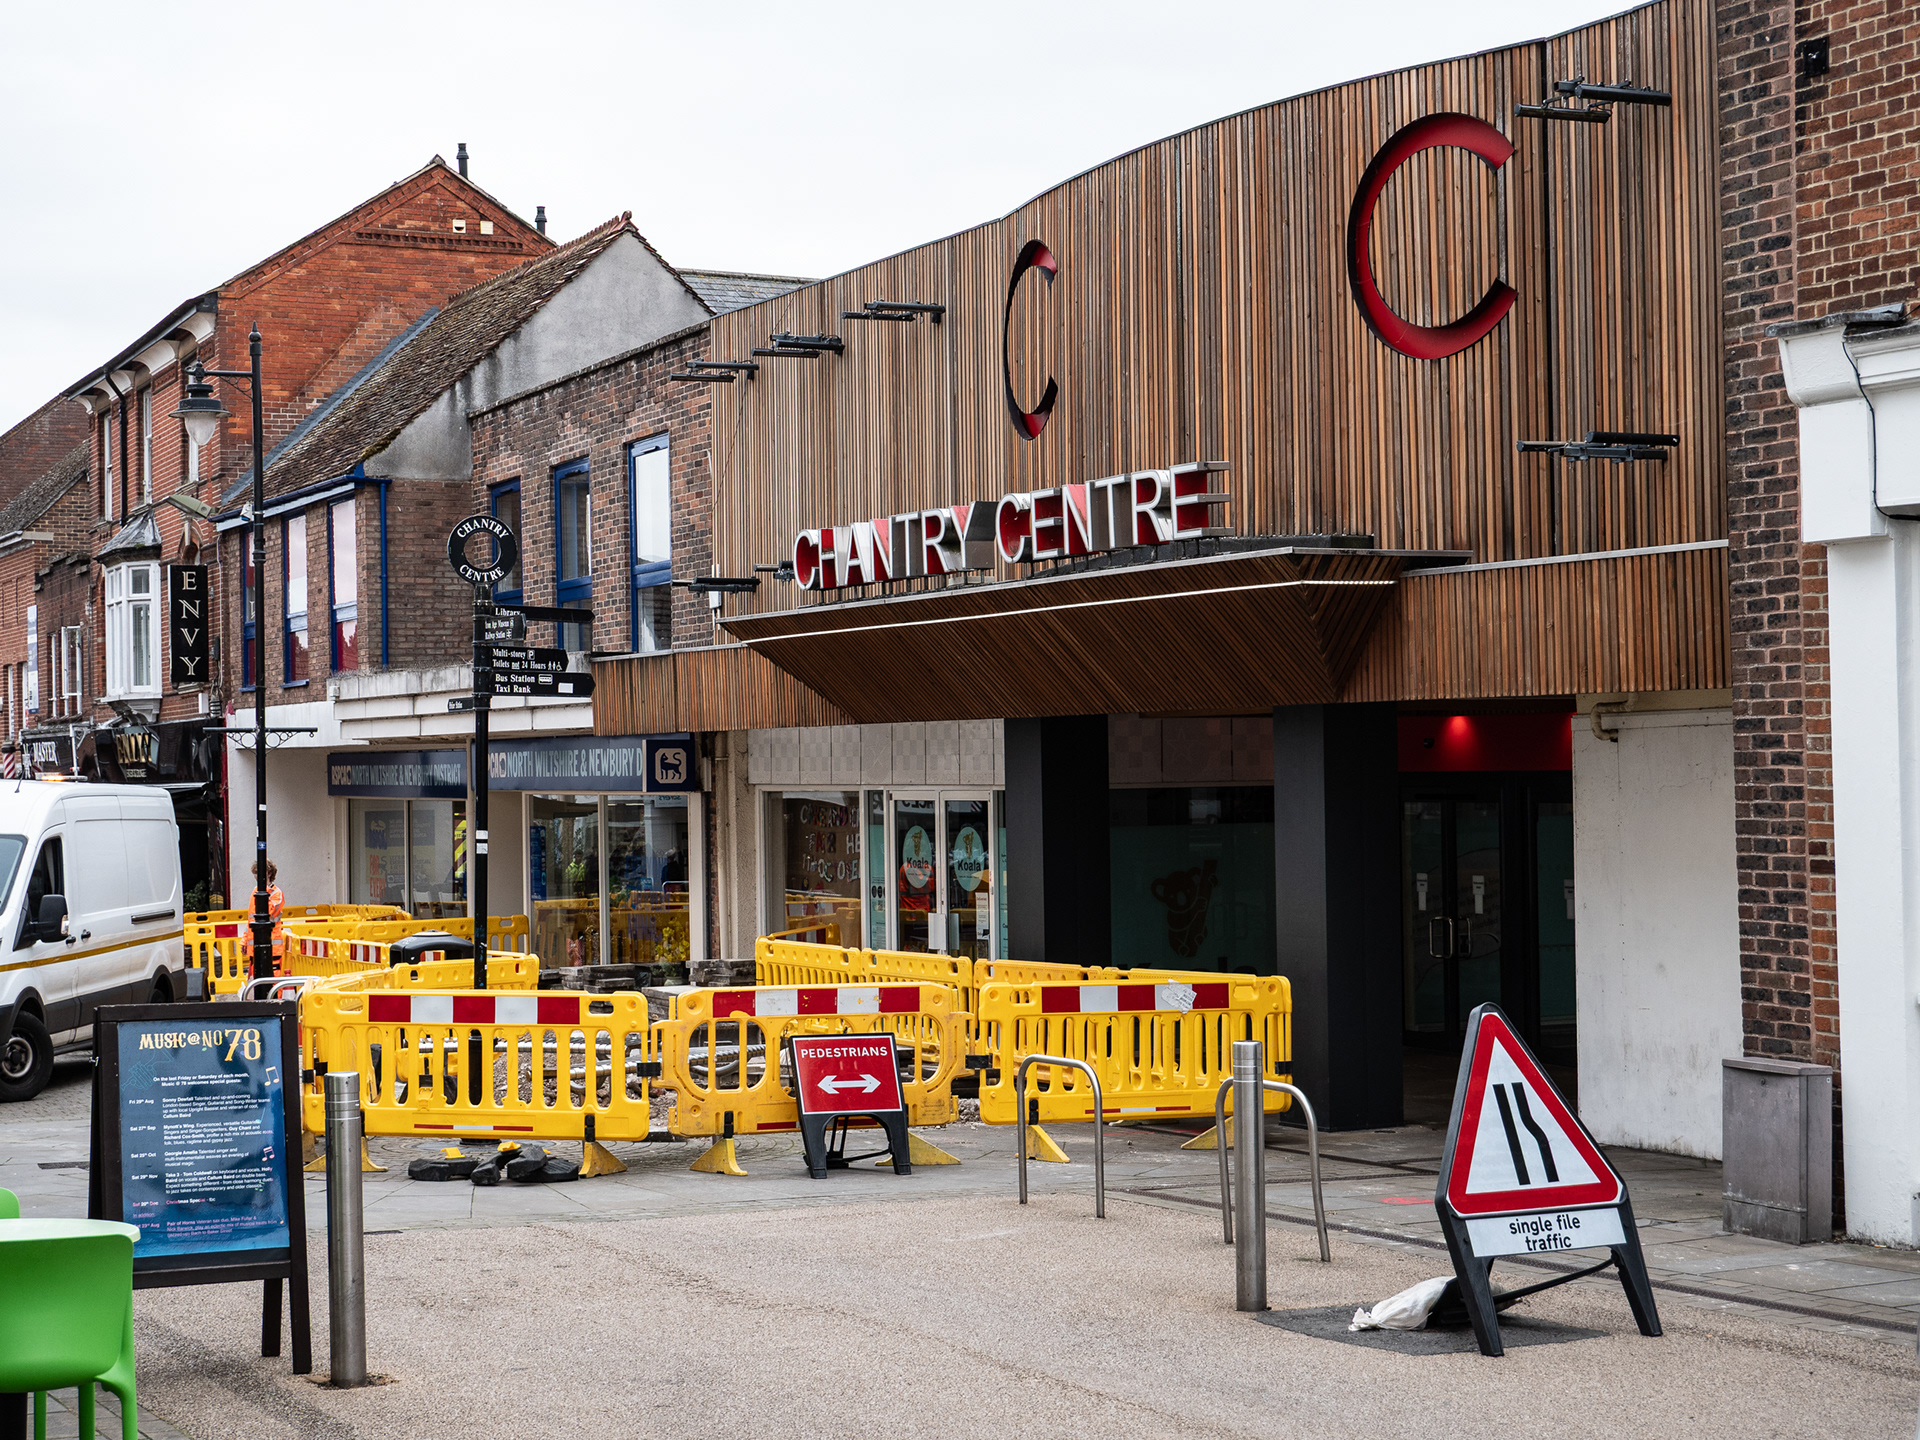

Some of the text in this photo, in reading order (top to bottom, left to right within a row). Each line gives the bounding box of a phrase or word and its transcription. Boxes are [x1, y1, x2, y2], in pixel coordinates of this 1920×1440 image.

[1346, 112, 1518, 360] C
[1002, 238, 1058, 441] C
[457, 518, 509, 540] CHANTRY
[793, 461, 1222, 591] CHANTRY CENTRE
[459, 564, 504, 582] CENTRE
[495, 608, 521, 617] Library
[179, 571, 201, 675] ENVY
[492, 649, 526, 659] Multi-storey
[492, 659, 546, 670] Toilets not 24 Hours
[495, 673, 535, 683] Bus Station
[495, 684, 531, 693] Taxi Rank
[507, 752, 533, 778] NORTH
[534, 750, 579, 778] WILTSHIRE
[580, 749, 587, 778] &
[589, 747, 635, 777] NEWBURY
[352, 765, 370, 785] NORTH
[370, 764, 399, 786] WILTSHIRE
[399, 764, 404, 786] &
[405, 764, 433, 787] NEWBURY
[434, 763, 461, 787] DISTRICT
[906, 857, 929, 870] Koala
[957, 858, 981, 873] Koala
[800, 1046, 888, 1059] PEDESTRIANS
[1509, 1213, 1581, 1236] single file
[1525, 1234, 1572, 1251] traffic
